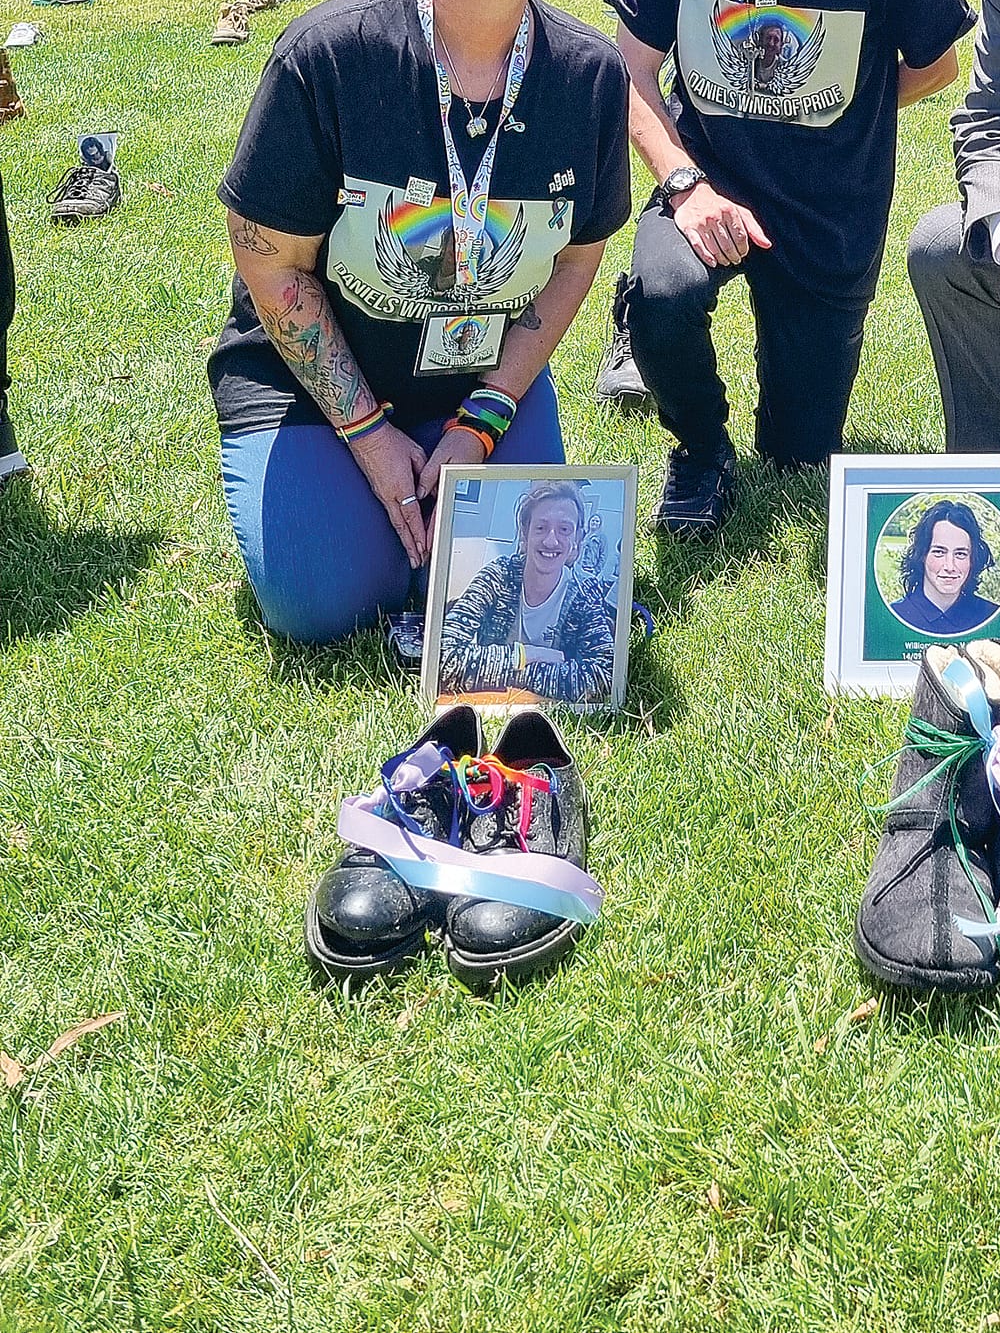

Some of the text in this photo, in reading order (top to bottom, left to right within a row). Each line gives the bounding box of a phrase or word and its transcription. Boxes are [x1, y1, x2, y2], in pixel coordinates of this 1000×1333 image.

[687, 70, 844, 117] DANIELS WINGS OF PRIDE
[333, 261, 400, 314] DANIELS
